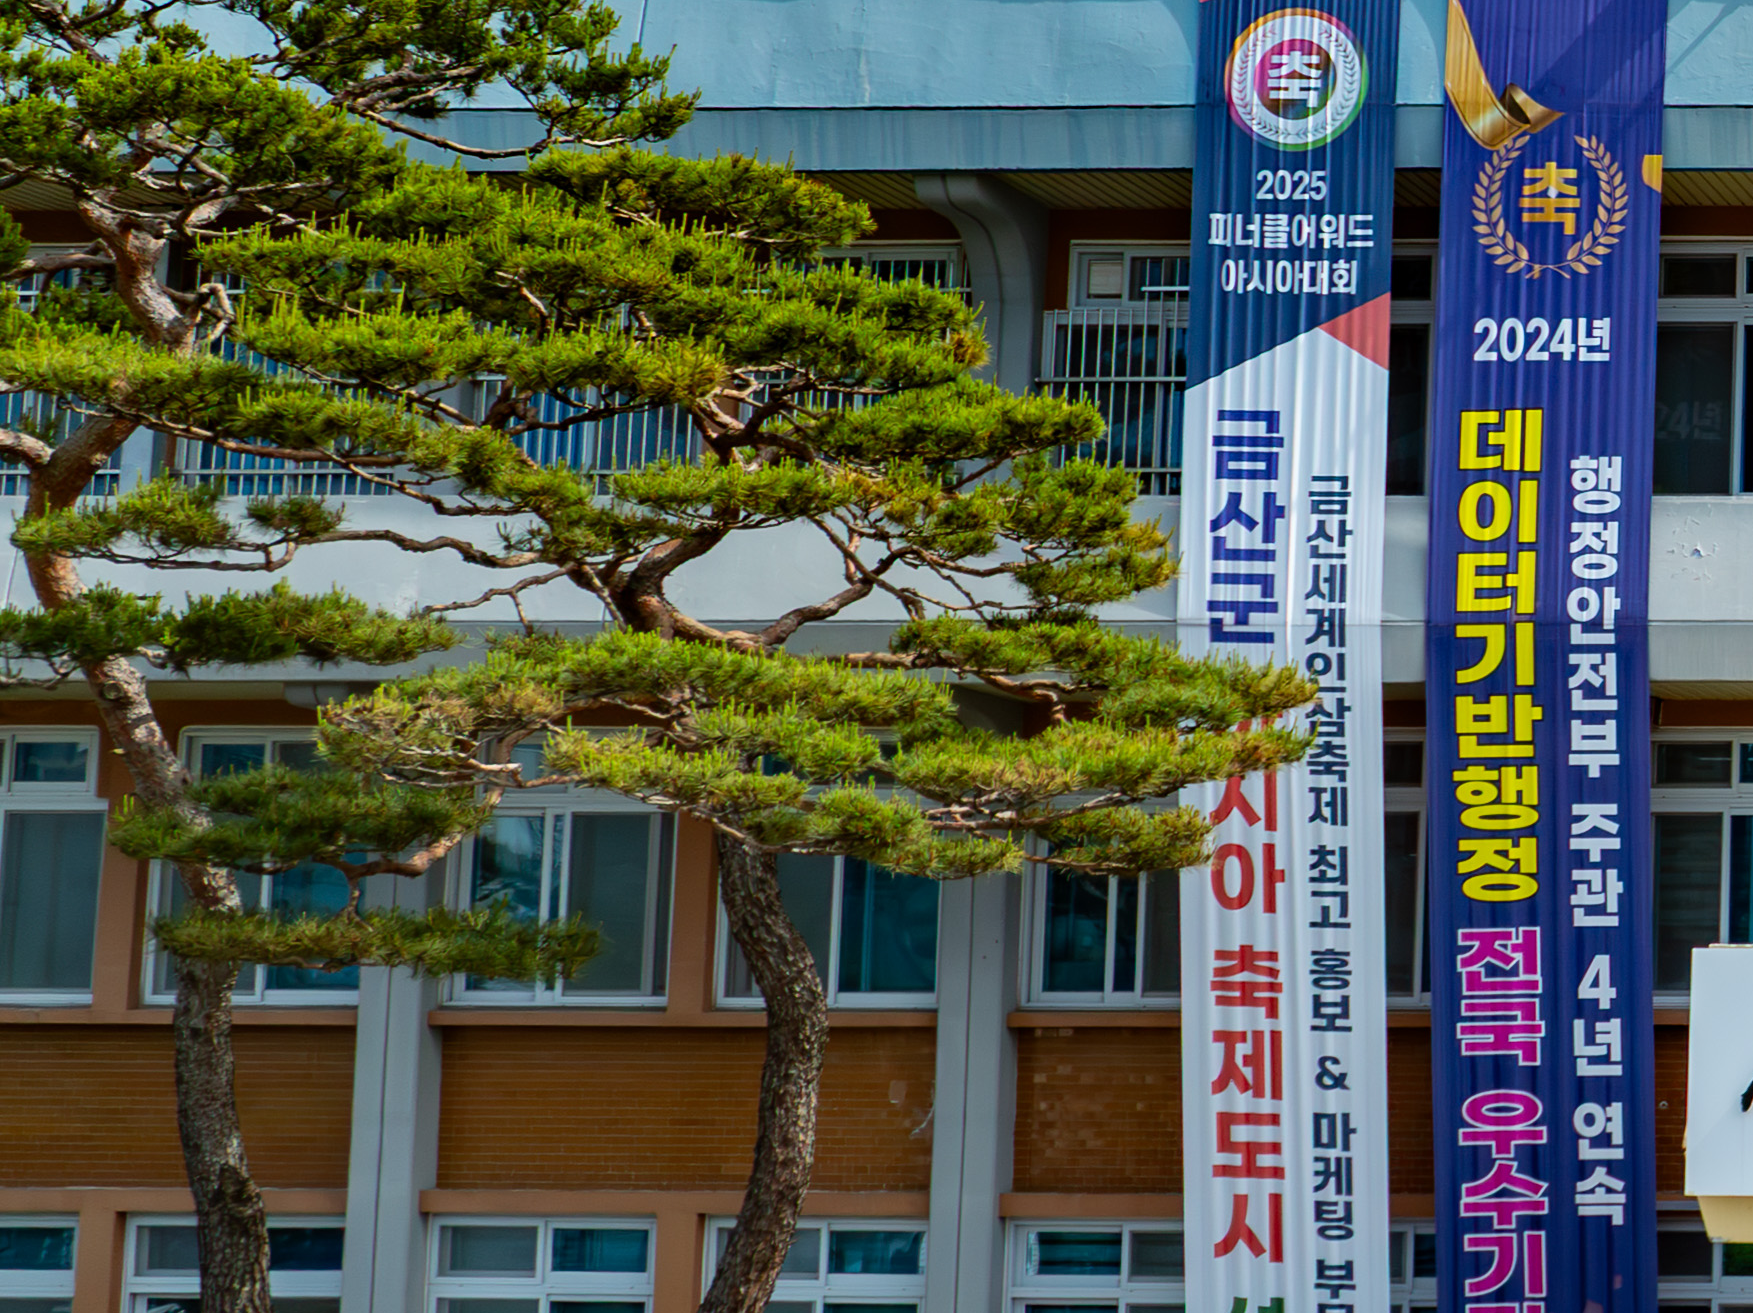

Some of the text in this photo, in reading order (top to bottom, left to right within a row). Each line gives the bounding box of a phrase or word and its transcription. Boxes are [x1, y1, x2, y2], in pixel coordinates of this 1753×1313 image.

[1267, 49, 1321, 108] 축
[1255, 170, 1327, 201] 2025
[1517, 163, 1580, 235] 축
[1208, 212, 1374, 250] 피너클어워드
[1221, 259, 1357, 296] 아시아대회
[1473, 317, 1611, 364] 2024년
[1207, 408, 1285, 644] 금산군
[1305, 476, 1353, 827] 금산세계인삼축제
[1453, 408, 1545, 904] 데이터기반행정
[1566, 456, 1627, 1227] 행정안전부 주관 4년 연속
[1308, 845, 1350, 930] 최고
[1309, 947, 1353, 1034] 홍보
[1456, 926, 1545, 1066] 전국
[1209, 945, 1287, 1264] 축제도시
[1315, 1056, 1349, 1090] &
[1312, 1112, 1356, 1242] 마케팅
